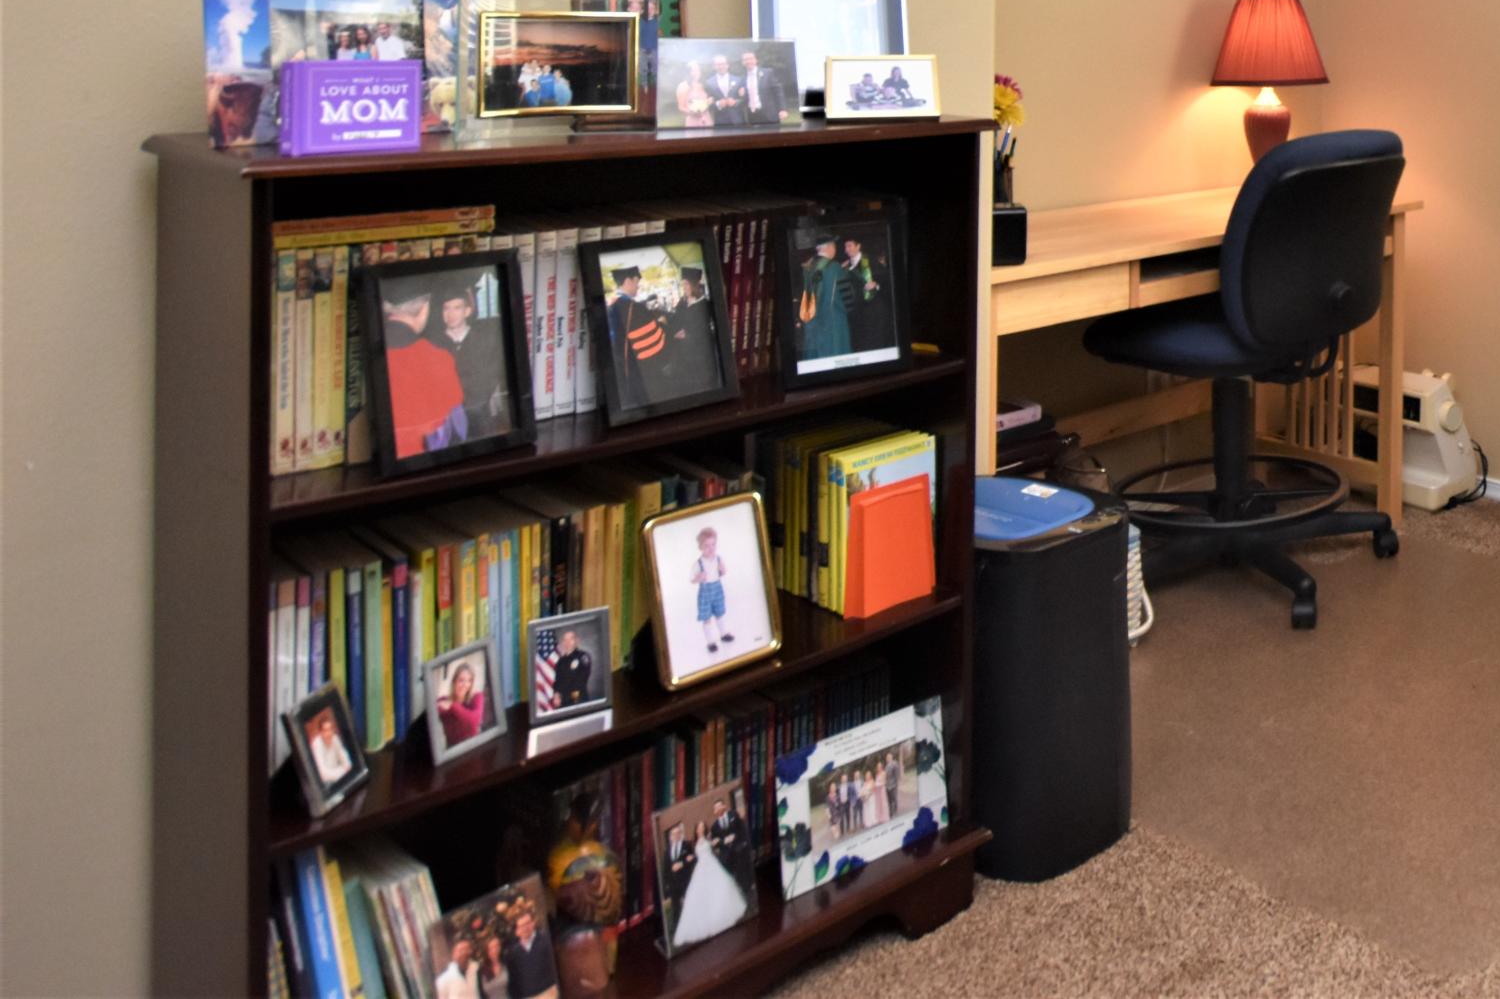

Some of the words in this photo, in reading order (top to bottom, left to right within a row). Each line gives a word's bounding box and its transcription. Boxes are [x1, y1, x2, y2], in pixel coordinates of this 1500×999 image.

[320, 85, 356, 97] LOVE
[362, 84, 409, 95] ABOUT
[320, 98, 409, 125] MOM
[547, 276, 557, 291] THE
[568, 278, 578, 299] KING
[546, 293, 556, 310] RED
[546, 311, 556, 341] BADGE
[545, 343, 555, 354] OF
[545, 355, 556, 394] COURAGE
